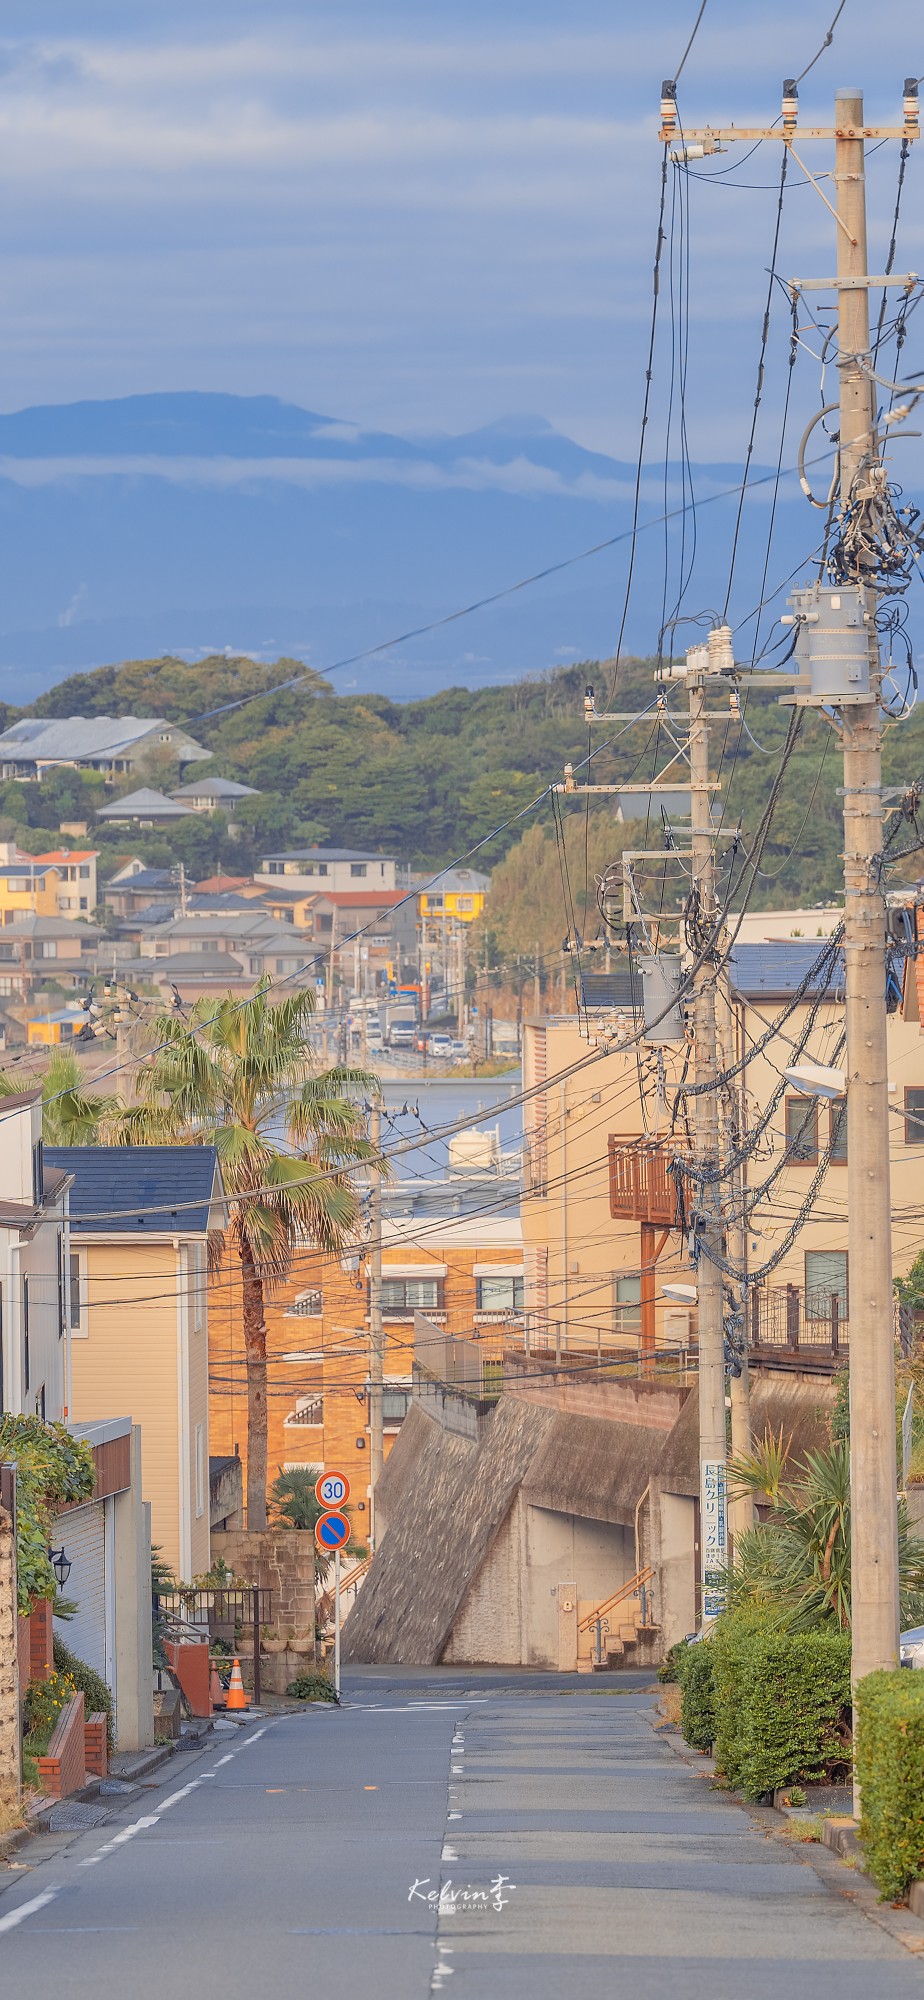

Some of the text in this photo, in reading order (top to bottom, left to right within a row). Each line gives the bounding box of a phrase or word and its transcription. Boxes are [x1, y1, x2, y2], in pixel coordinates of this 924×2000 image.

[324, 1481, 343, 1499] 30
[705, 1464, 717, 1546] 長島クリニック
